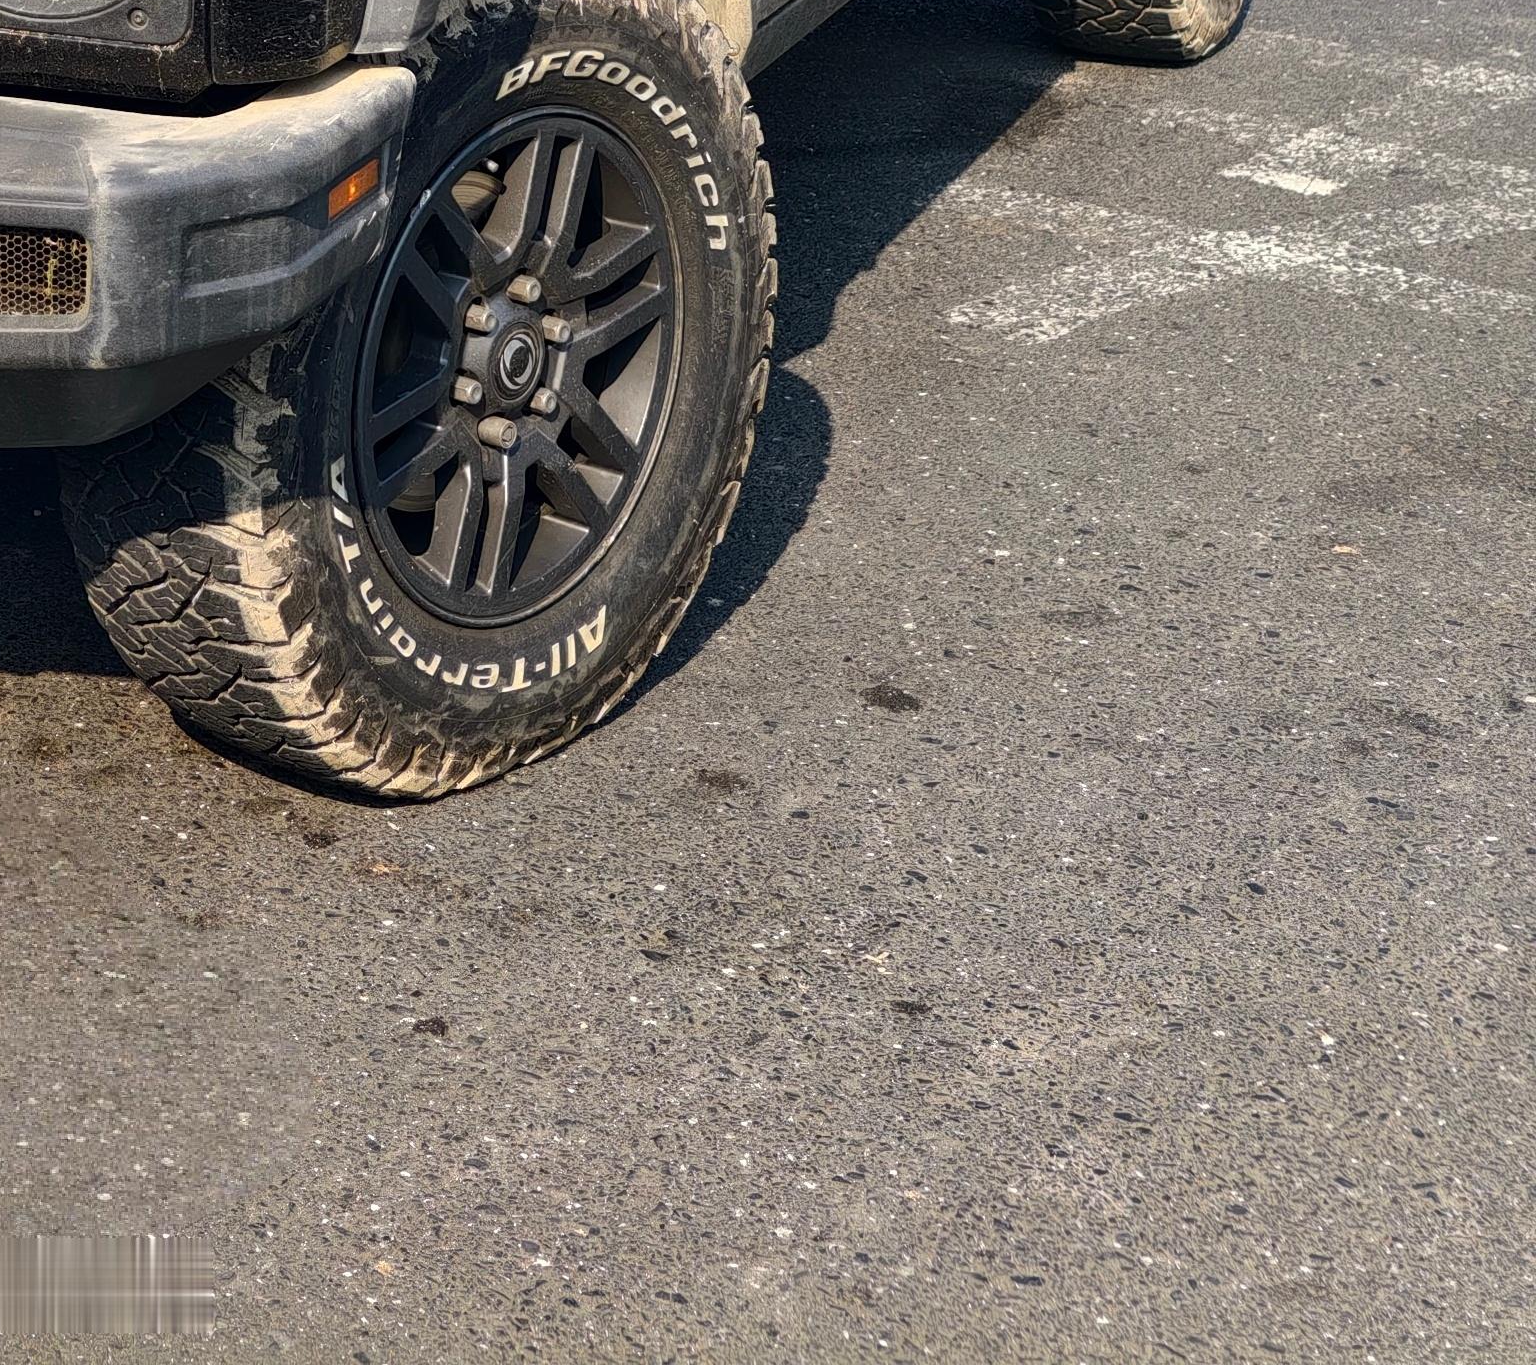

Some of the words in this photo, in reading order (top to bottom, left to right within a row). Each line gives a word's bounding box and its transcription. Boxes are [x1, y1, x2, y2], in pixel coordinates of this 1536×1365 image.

[494, 49, 730, 252] BFGoodrich
[330, 453, 362, 574] T/A
[359, 577, 608, 694] All-Terrain
